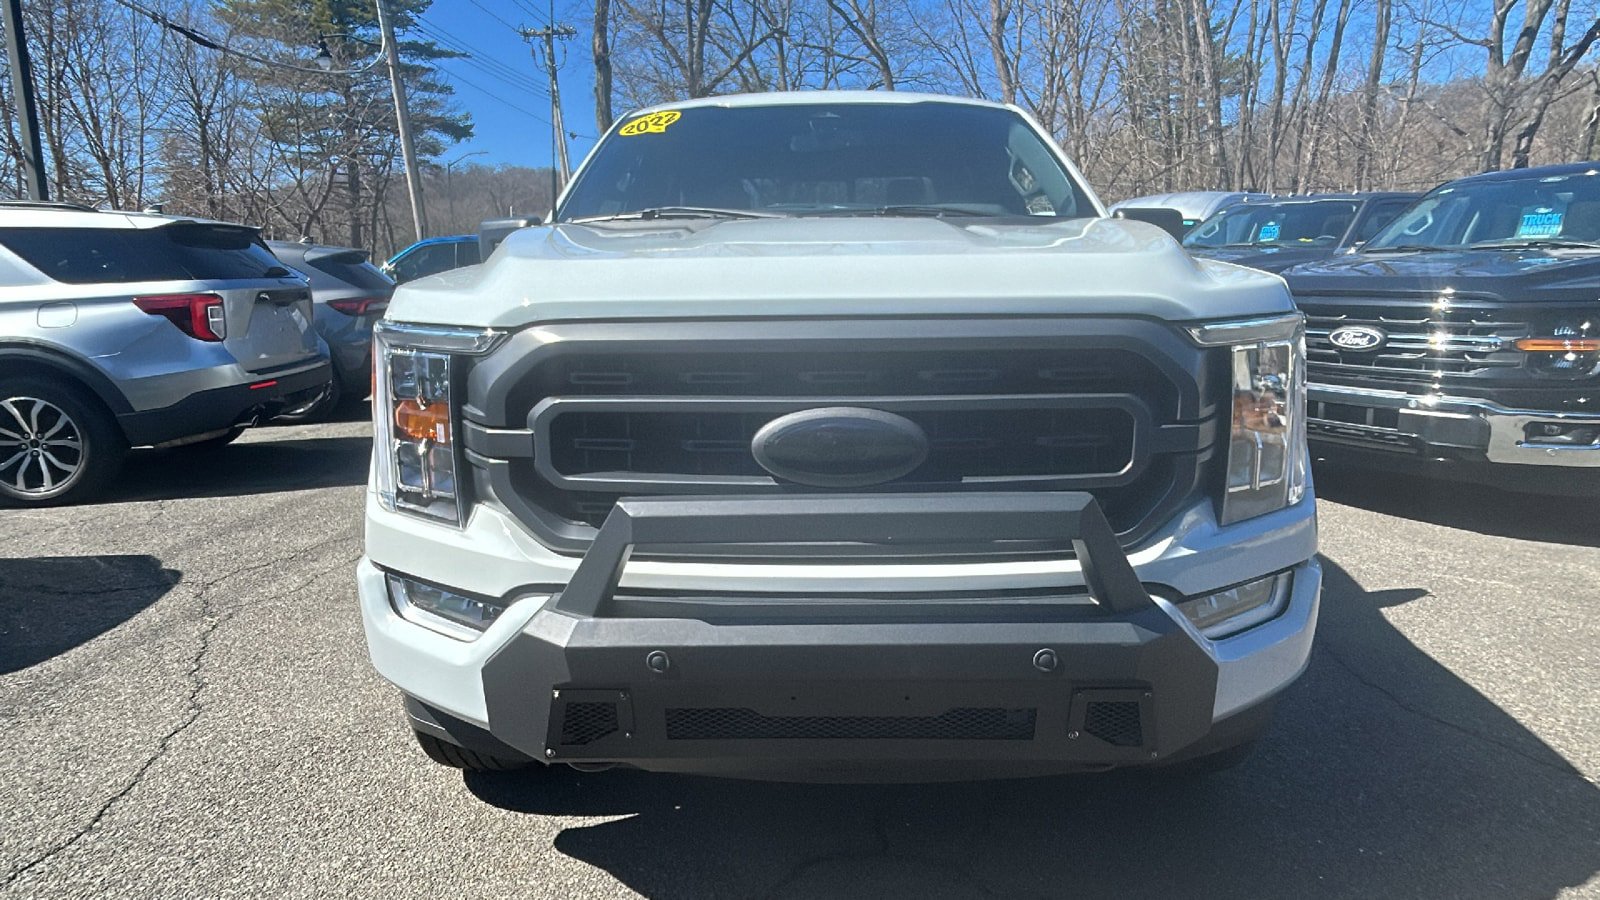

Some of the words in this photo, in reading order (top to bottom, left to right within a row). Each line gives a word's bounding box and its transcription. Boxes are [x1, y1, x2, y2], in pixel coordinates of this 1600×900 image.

[624, 112, 678, 134] 2022
[1522, 213, 1562, 226] TRUCK
[1338, 331, 1371, 346] Ford
